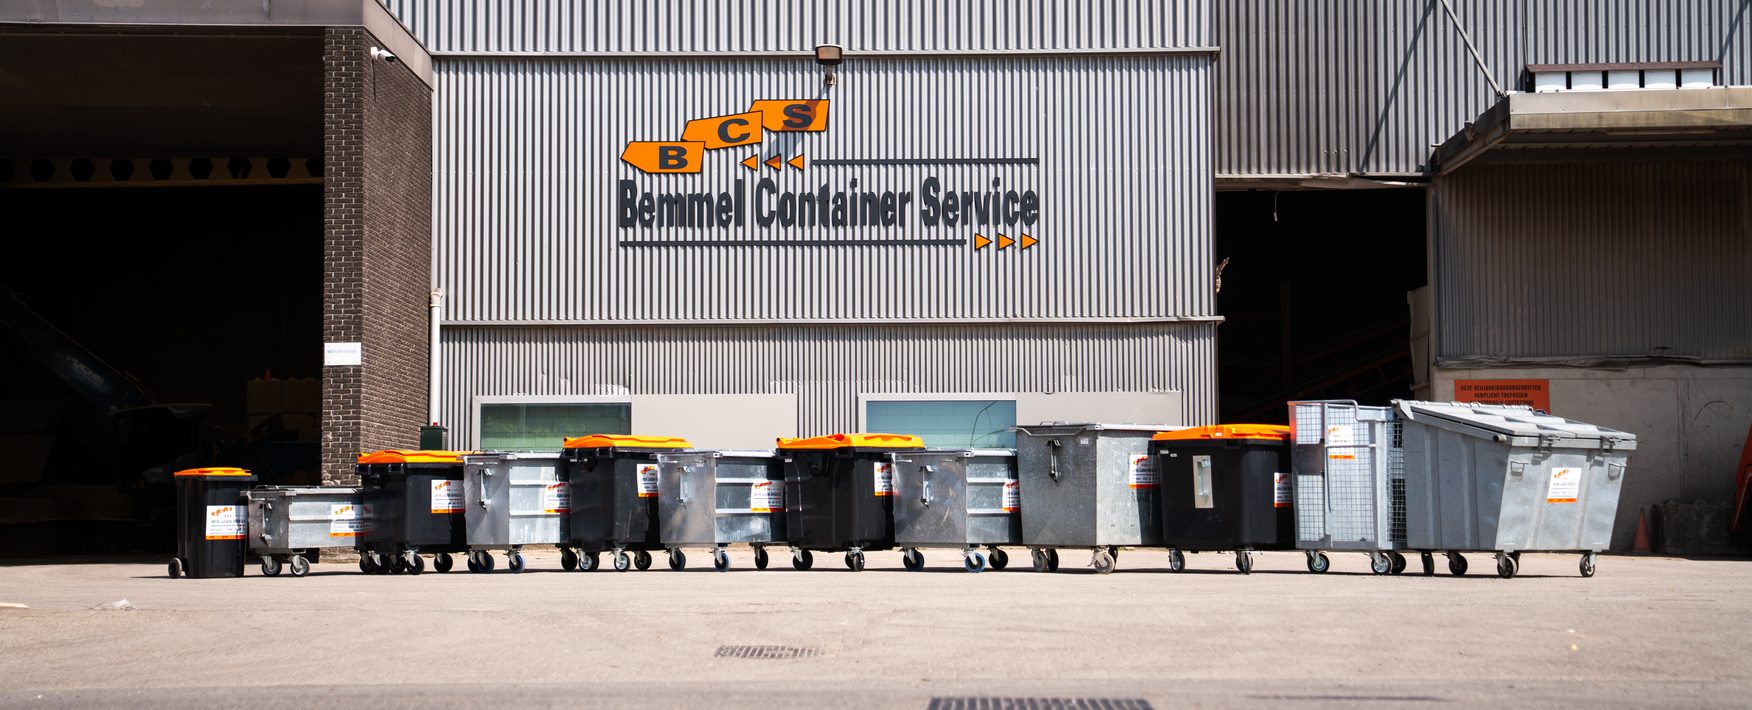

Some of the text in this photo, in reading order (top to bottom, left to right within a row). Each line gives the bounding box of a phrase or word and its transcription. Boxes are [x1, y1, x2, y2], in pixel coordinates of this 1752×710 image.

[619, 176, 1039, 228] Bemmel Container Service
